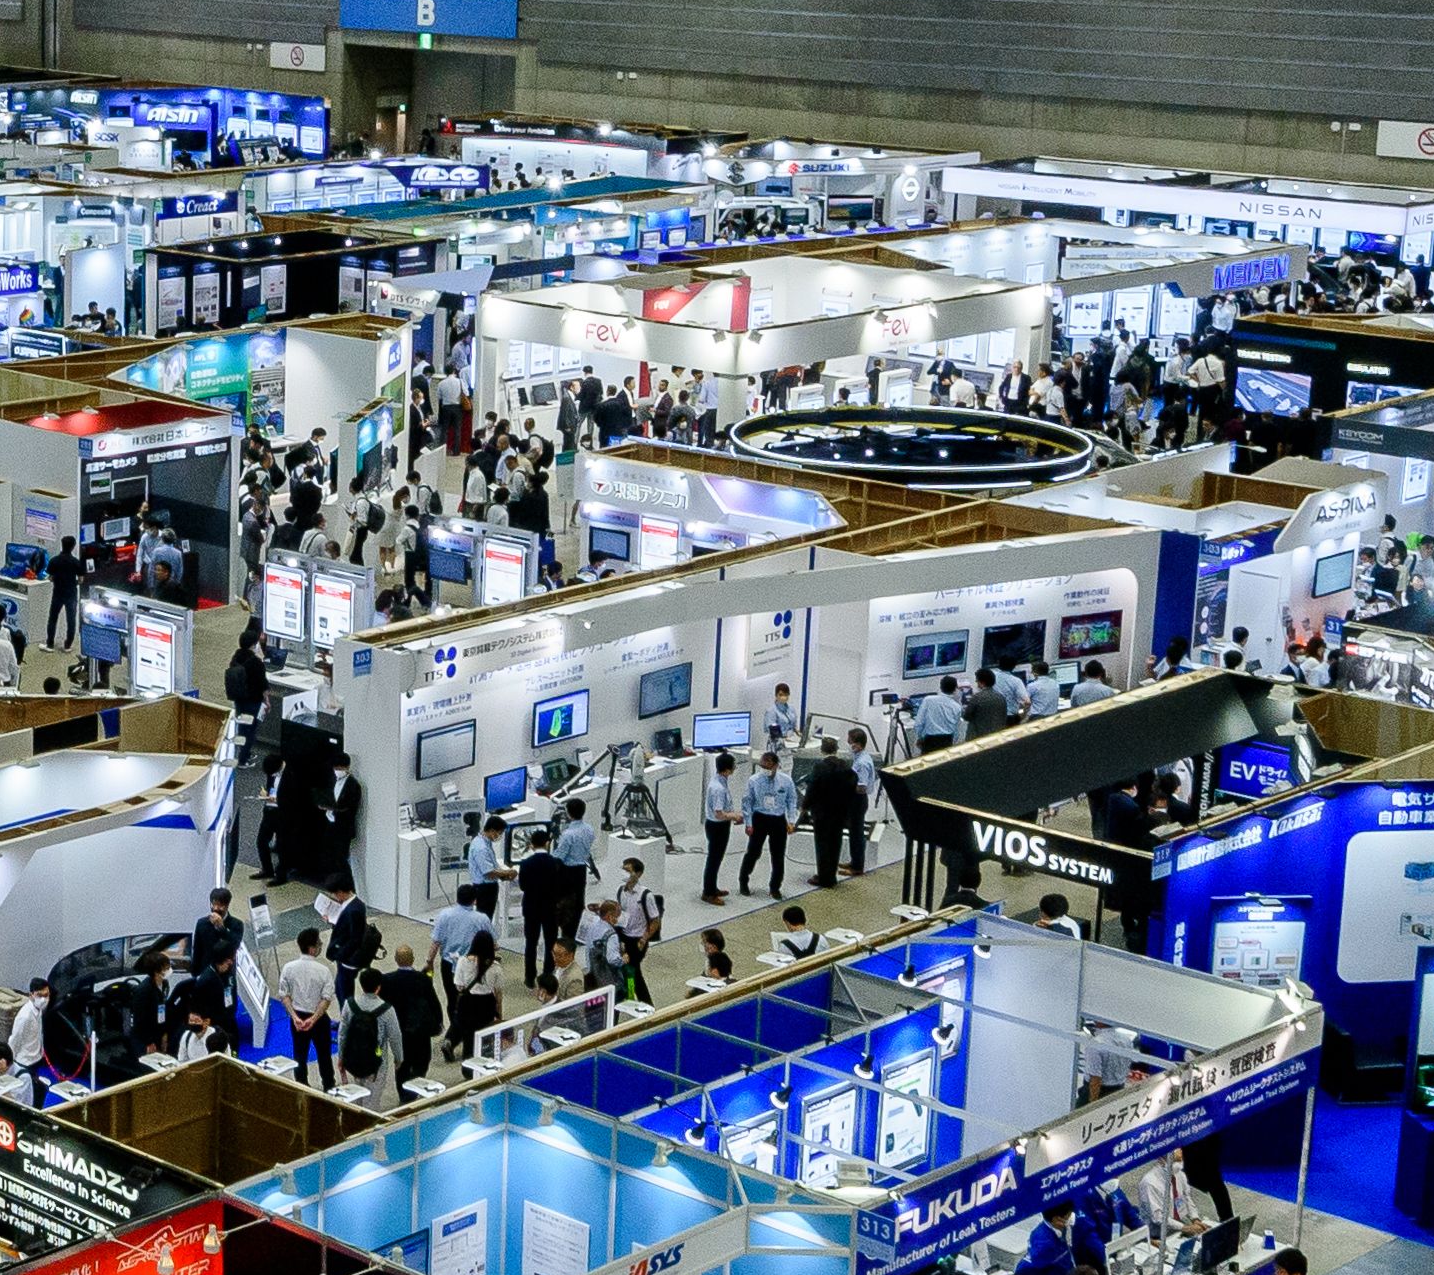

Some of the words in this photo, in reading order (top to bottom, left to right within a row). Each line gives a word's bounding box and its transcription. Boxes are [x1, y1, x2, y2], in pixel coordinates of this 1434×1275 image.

[70, 92, 98, 105] AISIN
[147, 106, 200, 124] AISIN
[803, 164, 850, 174] SUZUKI
[186, 196, 218, 213] Creact
[1239, 202, 1322, 220] NISSAN
[132, 426, 217, 448] 株式会社日本レーザー
[764, 632, 781, 643] TTS
[424, 670, 444, 683] TTS
[972, 820, 1046, 867] VIOS
[1048, 851, 1114, 884] SYSTEM
[17, 1135, 139, 1203] SHIMADZU
[23, 1159, 76, 1192] Excellence
[90, 1192, 132, 1219] Science
[894, 1166, 1019, 1244] FUKUDA
[859, 1212, 892, 1239] 313
[951, 1222, 976, 1243] Leak
[977, 1206, 1017, 1234] Testers
